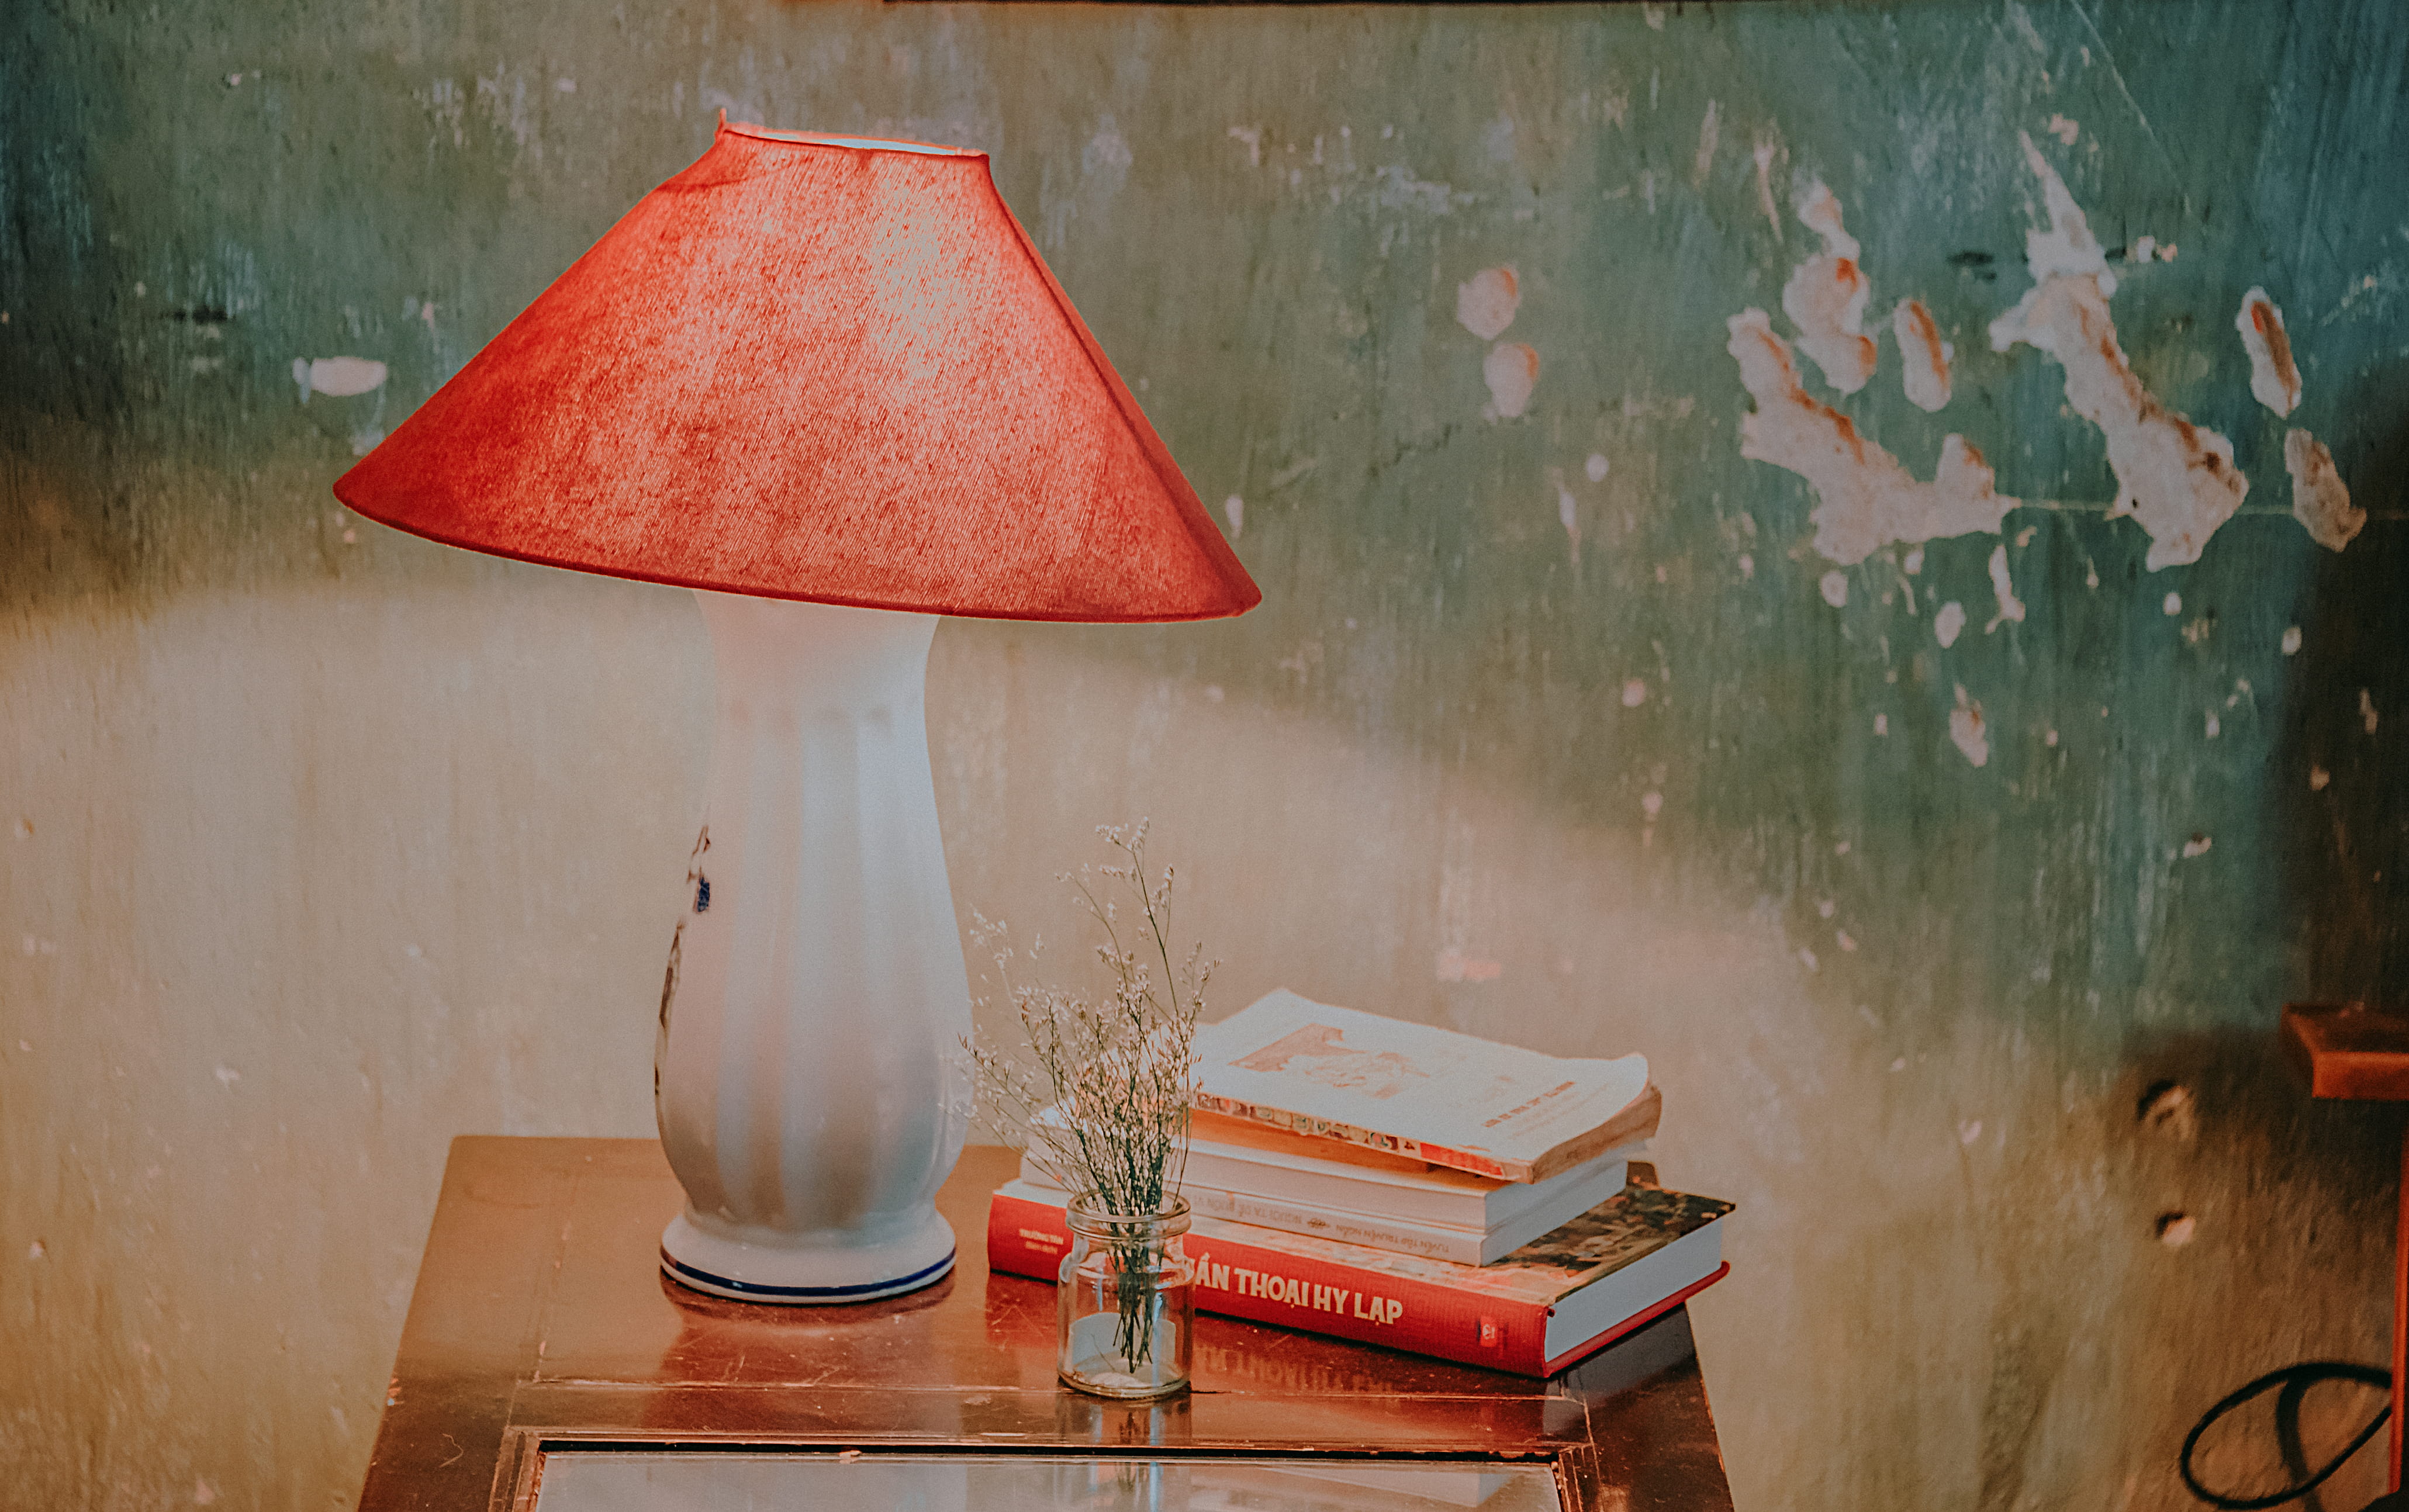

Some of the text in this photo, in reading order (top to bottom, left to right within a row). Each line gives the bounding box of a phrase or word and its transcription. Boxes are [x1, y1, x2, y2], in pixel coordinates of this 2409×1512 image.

[1234, 1267, 1309, 1308] THOẠI
[1314, 1284, 1349, 1314] HY
[1354, 1292, 1403, 1326] LẠP
